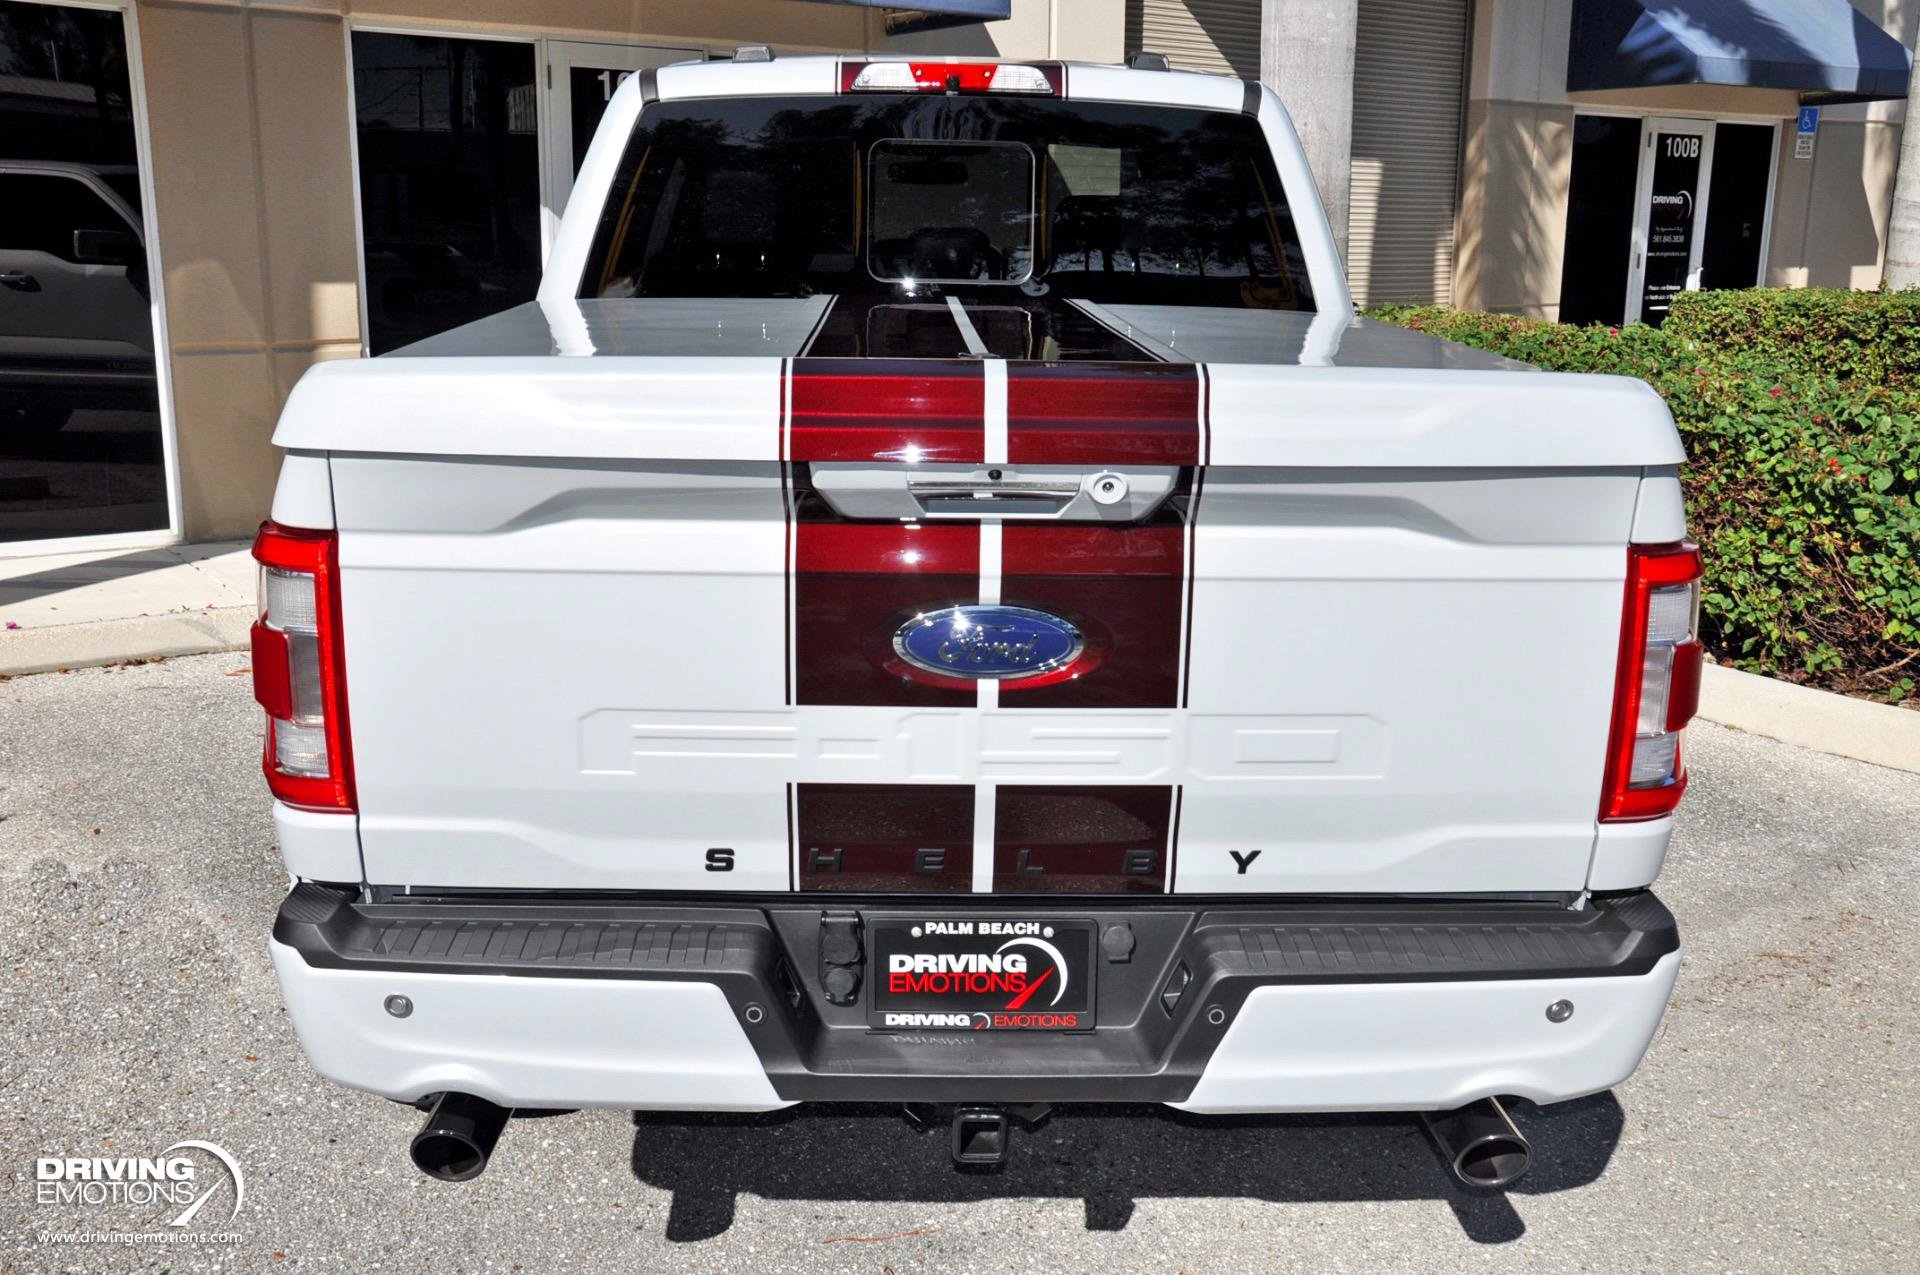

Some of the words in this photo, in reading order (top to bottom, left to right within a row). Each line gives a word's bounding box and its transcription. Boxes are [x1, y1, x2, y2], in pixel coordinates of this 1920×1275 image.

[1666, 137, 1700, 158] 100B
[1652, 195, 1684, 205] DRIVING
[937, 620, 1039, 664] Ford
[704, 847, 1263, 876] SHELBY
[925, 922, 974, 935] PALM
[978, 922, 1040, 935] BEACH
[889, 954, 1027, 973] DRIVING
[889, 972, 1027, 993] EMOTIONS
[885, 1014, 970, 1026] DRIVING
[994, 1014, 1077, 1027] EMOTIONS
